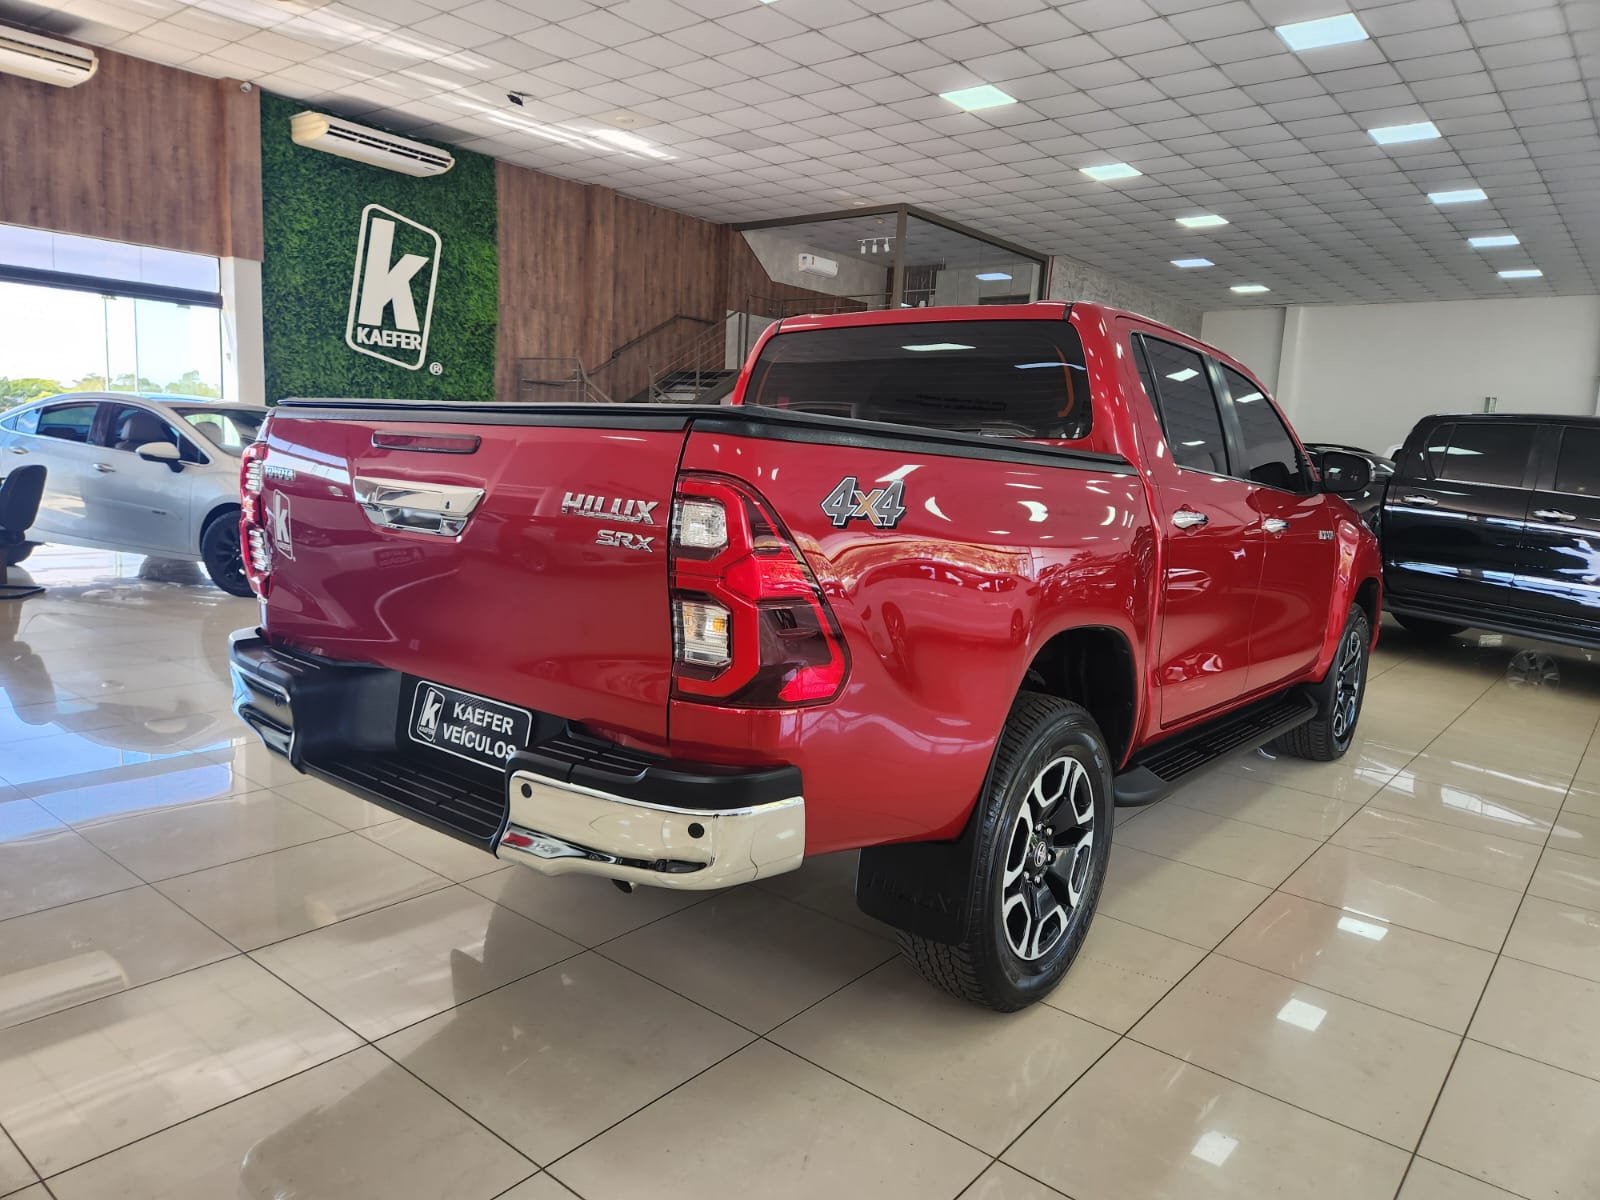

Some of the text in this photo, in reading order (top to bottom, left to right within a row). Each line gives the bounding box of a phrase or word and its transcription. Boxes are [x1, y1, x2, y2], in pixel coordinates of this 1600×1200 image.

[357, 327, 421, 350] KAEFER
[561, 491, 659, 525] HILUX
[595, 529, 655, 553] SRX
[453, 702, 514, 735] KAEFER
[443, 722, 517, 760] VEÍCULOS
